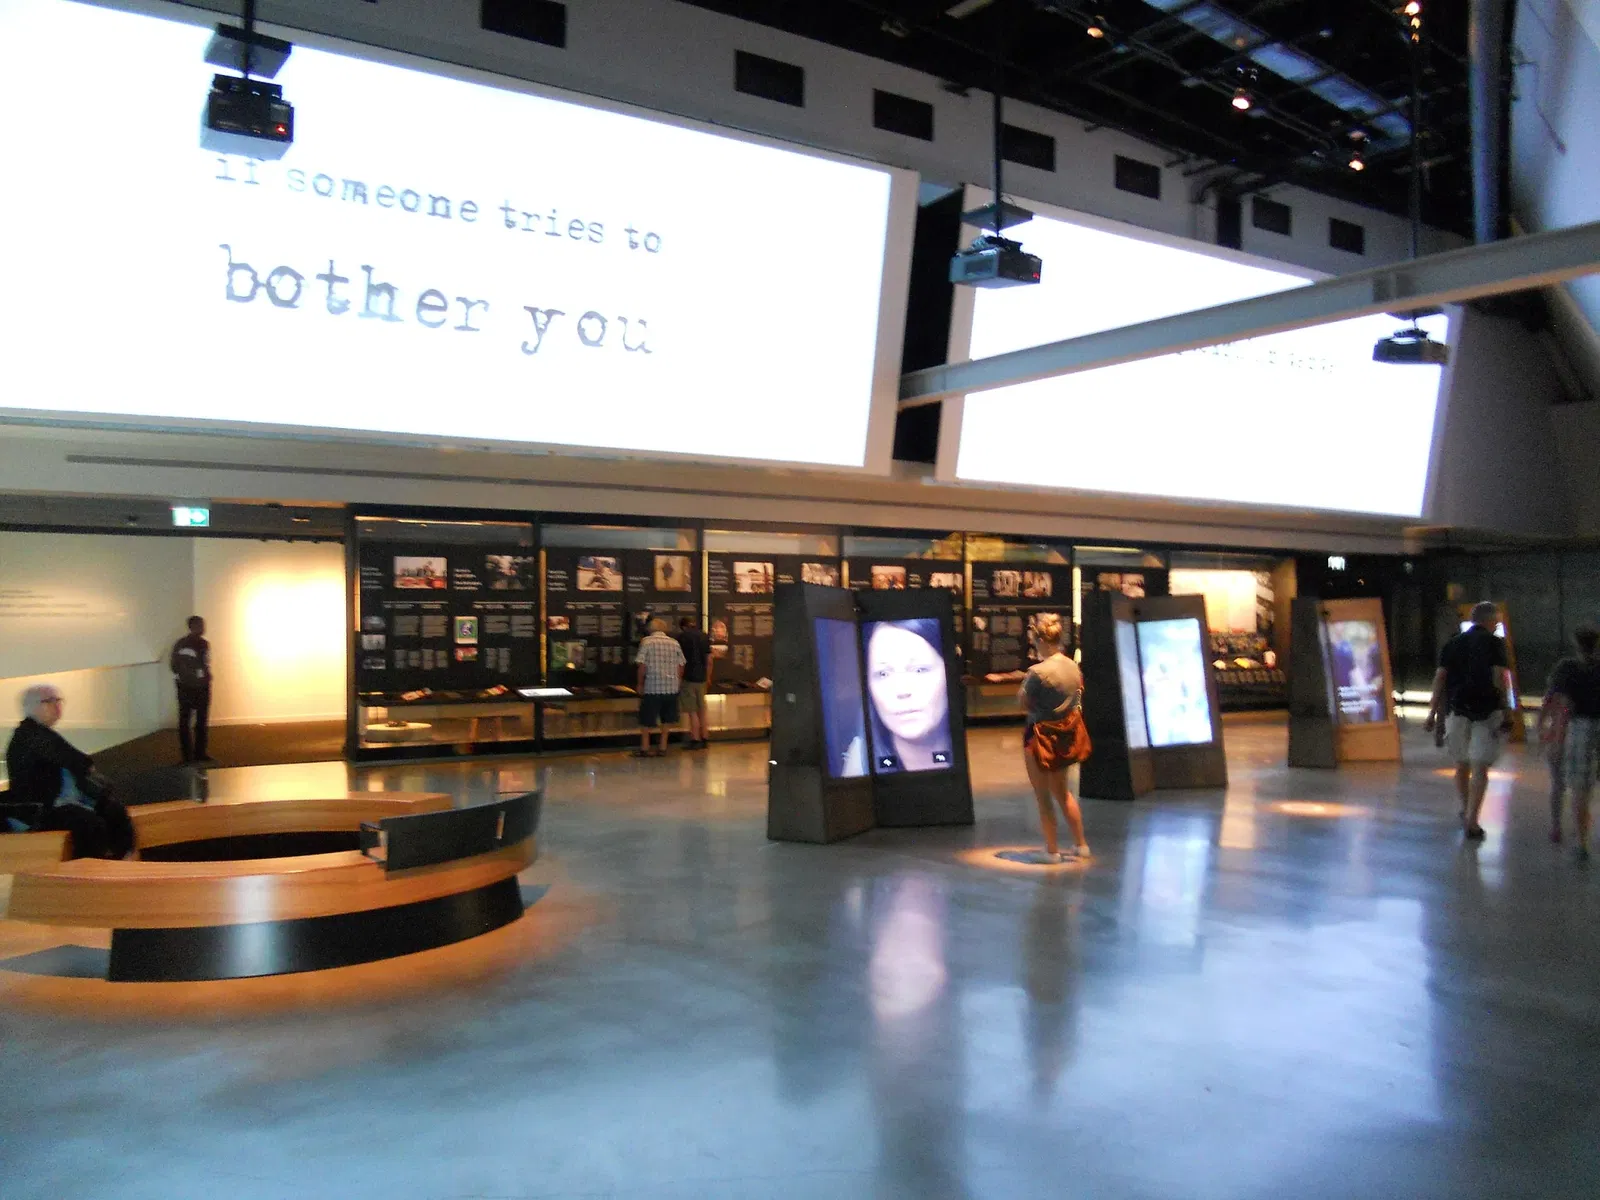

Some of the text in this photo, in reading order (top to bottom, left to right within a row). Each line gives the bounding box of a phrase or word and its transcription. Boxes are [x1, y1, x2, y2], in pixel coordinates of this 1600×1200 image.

[287, 168, 480, 223] someone
[498, 199, 604, 244] tries
[623, 223, 663, 254] to
[218, 243, 653, 356] bother you
